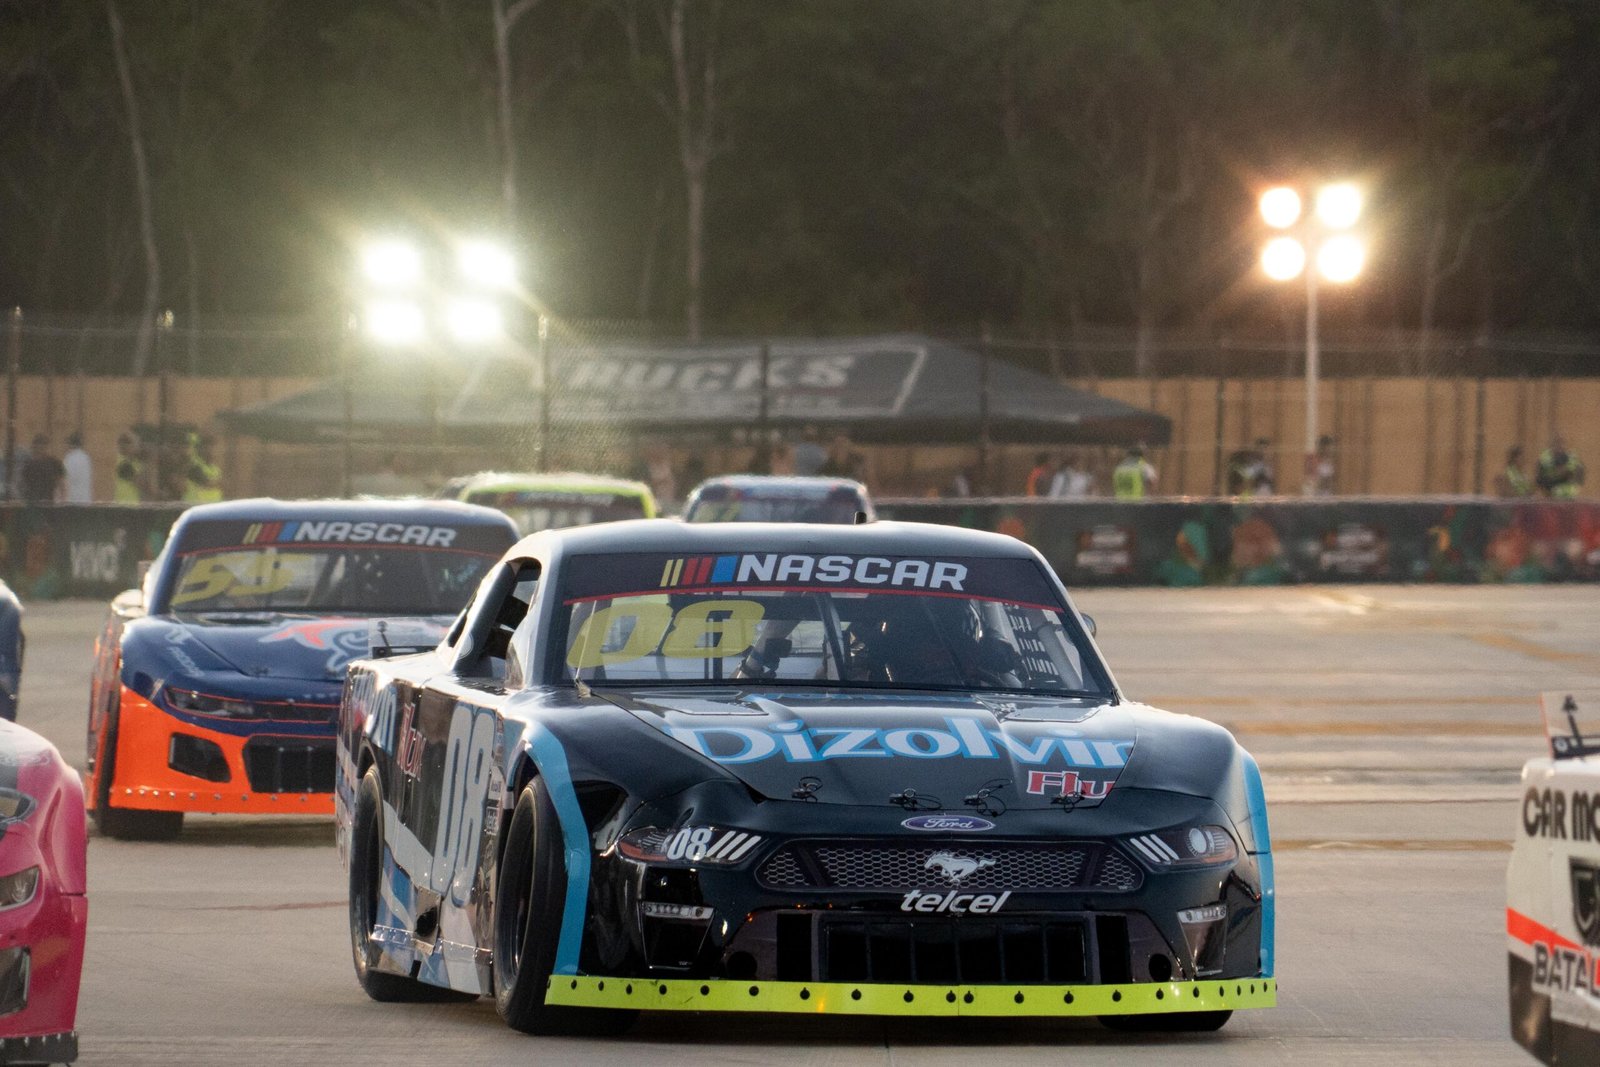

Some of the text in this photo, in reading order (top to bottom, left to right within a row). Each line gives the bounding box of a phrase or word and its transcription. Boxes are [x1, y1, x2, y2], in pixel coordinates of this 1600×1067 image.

[295, 520, 457, 547] NASCAR
[736, 554, 968, 591] NASCAR
[566, 599, 766, 669] 08
[431, 704, 496, 907] 08
[1523, 788, 1567, 841] CAR
[923, 817, 975, 830] Ford
[666, 828, 713, 861] 08
[900, 889, 1012, 915] telcel
